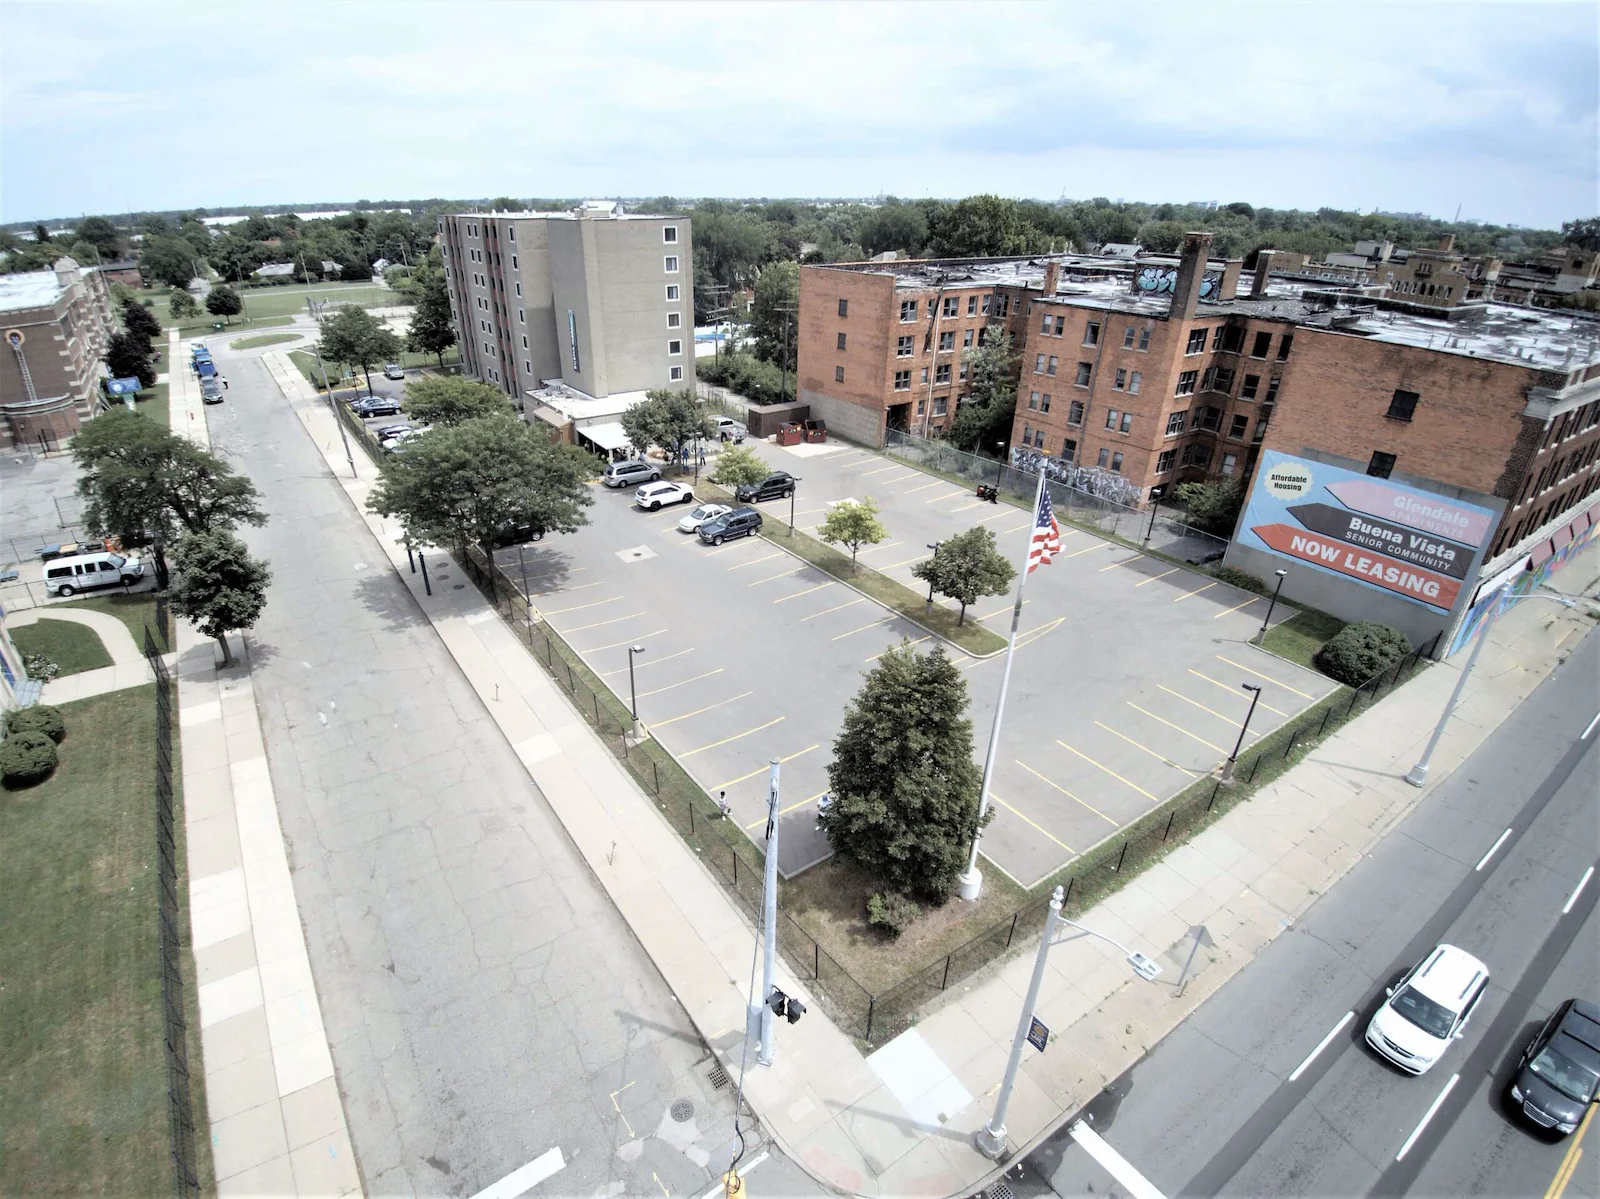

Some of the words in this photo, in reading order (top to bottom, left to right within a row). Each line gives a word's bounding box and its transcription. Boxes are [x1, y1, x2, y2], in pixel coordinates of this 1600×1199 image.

[1271, 474, 1307, 483] Affordable
[1274, 482, 1302, 491] Housing
[1388, 510, 1465, 538] APARTMENTS
[1393, 495, 1470, 528] Glendale
[1345, 531, 1383, 549] SENIOR
[1387, 545, 1452, 571] COMMUNITY
[1349, 517, 1403, 544] Buena
[1409, 535, 1456, 561] Vista
[1290, 535, 1341, 563] NOW
[1344, 553, 1440, 598] LEASING
